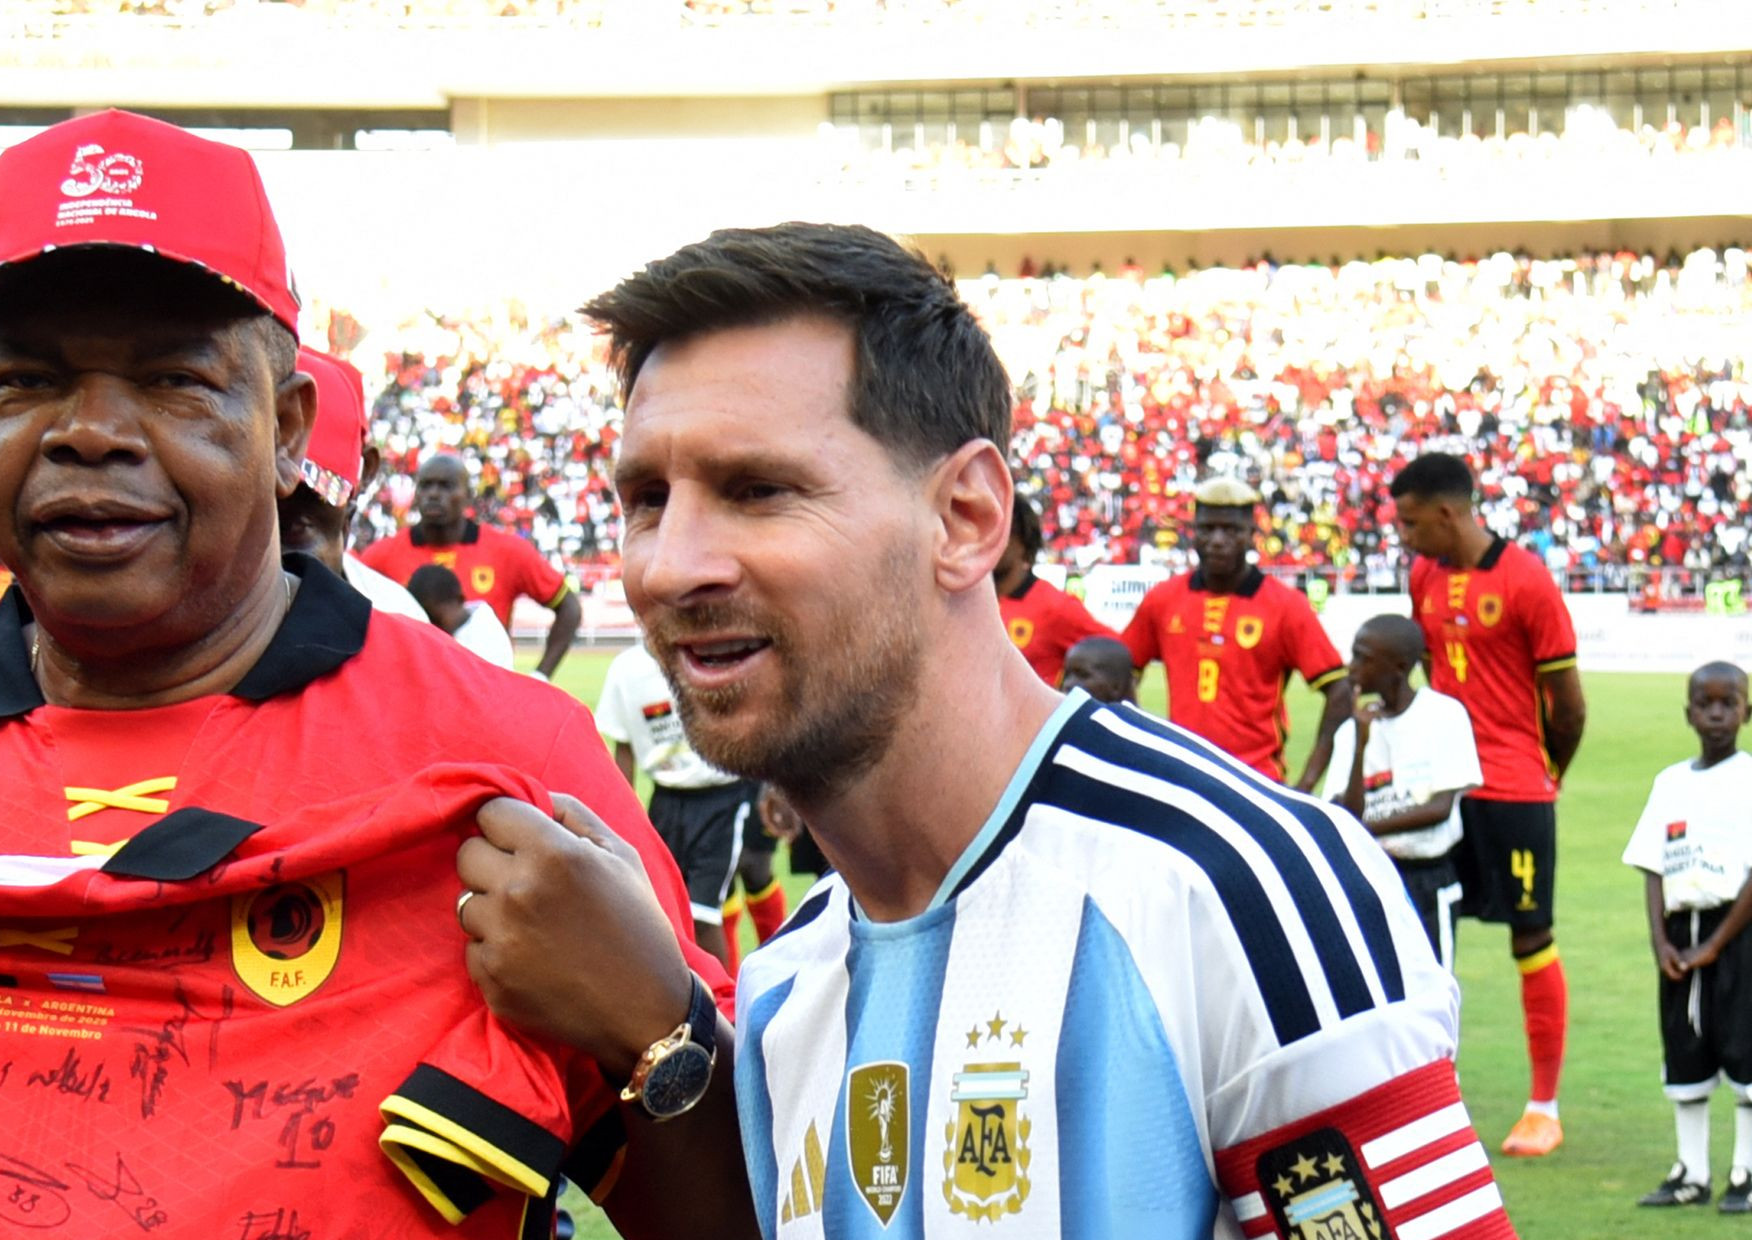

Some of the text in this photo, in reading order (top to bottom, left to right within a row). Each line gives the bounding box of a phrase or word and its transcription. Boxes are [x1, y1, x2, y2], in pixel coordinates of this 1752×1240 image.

[60, 143, 144, 197] 50
[1199, 658, 1220, 703] 8
[1445, 640, 1468, 684] 4
[1511, 848, 1535, 892] 4
[41, 1000, 116, 1017] ARGENTINA
[59, 1014, 76, 1024] de
[4, 1022, 19, 1032] 11
[20, 1024, 37, 1035] de
[38, 1026, 103, 1041] Novembro
[957, 1103, 1012, 1177] AFA
[872, 1165, 898, 1185] FIFA
